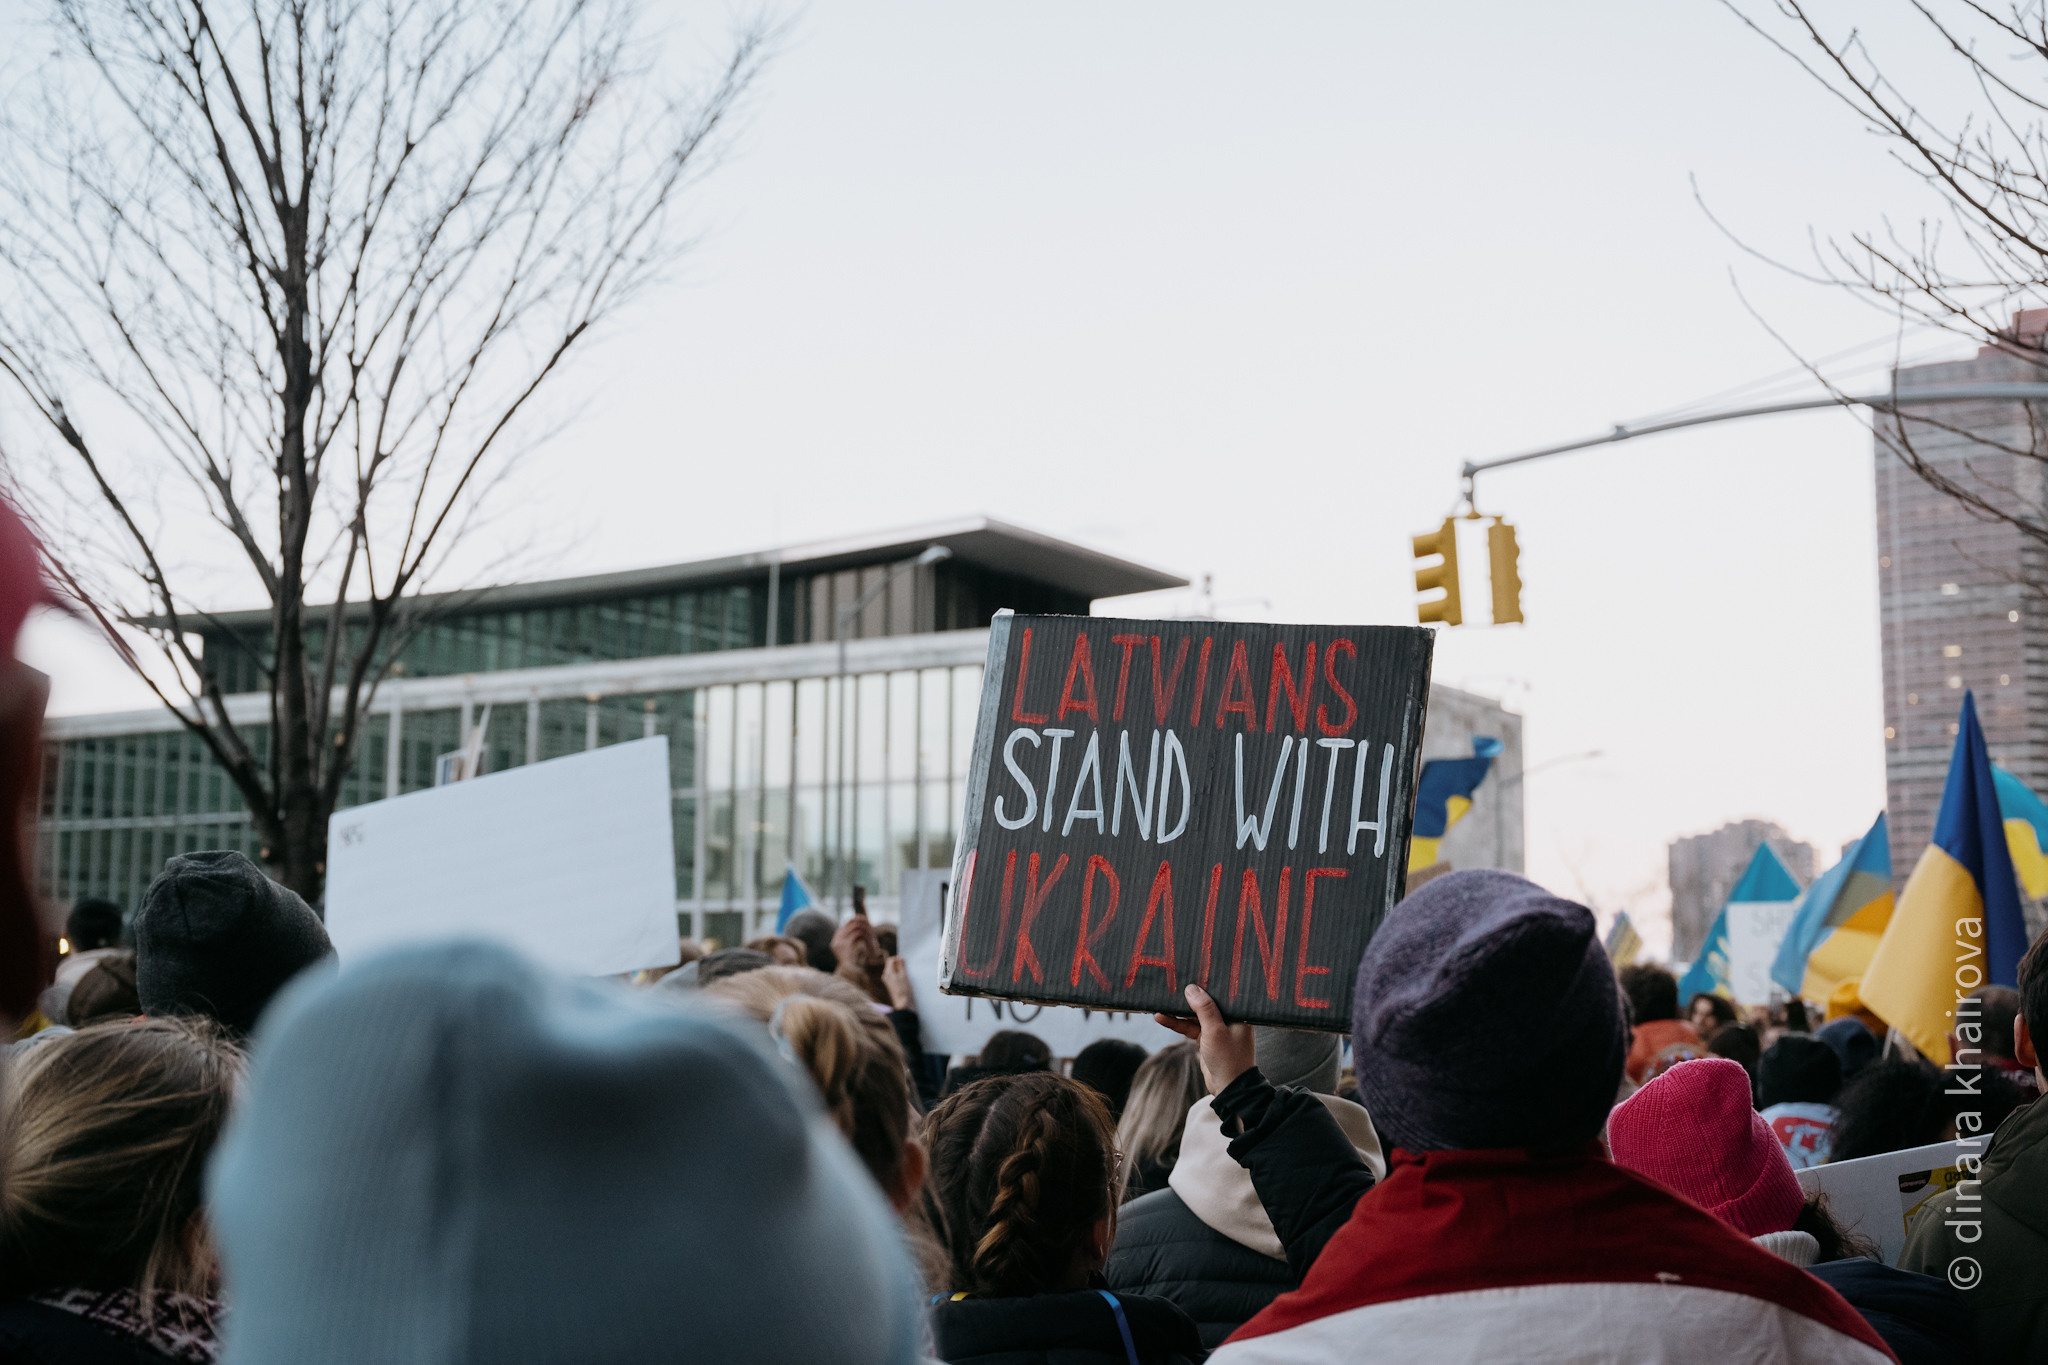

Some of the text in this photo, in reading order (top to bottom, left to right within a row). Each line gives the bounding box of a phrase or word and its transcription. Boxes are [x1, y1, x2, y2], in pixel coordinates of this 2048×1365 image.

[1011, 627, 1357, 736] LATVIANS
[995, 727, 1395, 858] STAND WITH
[957, 849, 1350, 1009] UKRAINE
